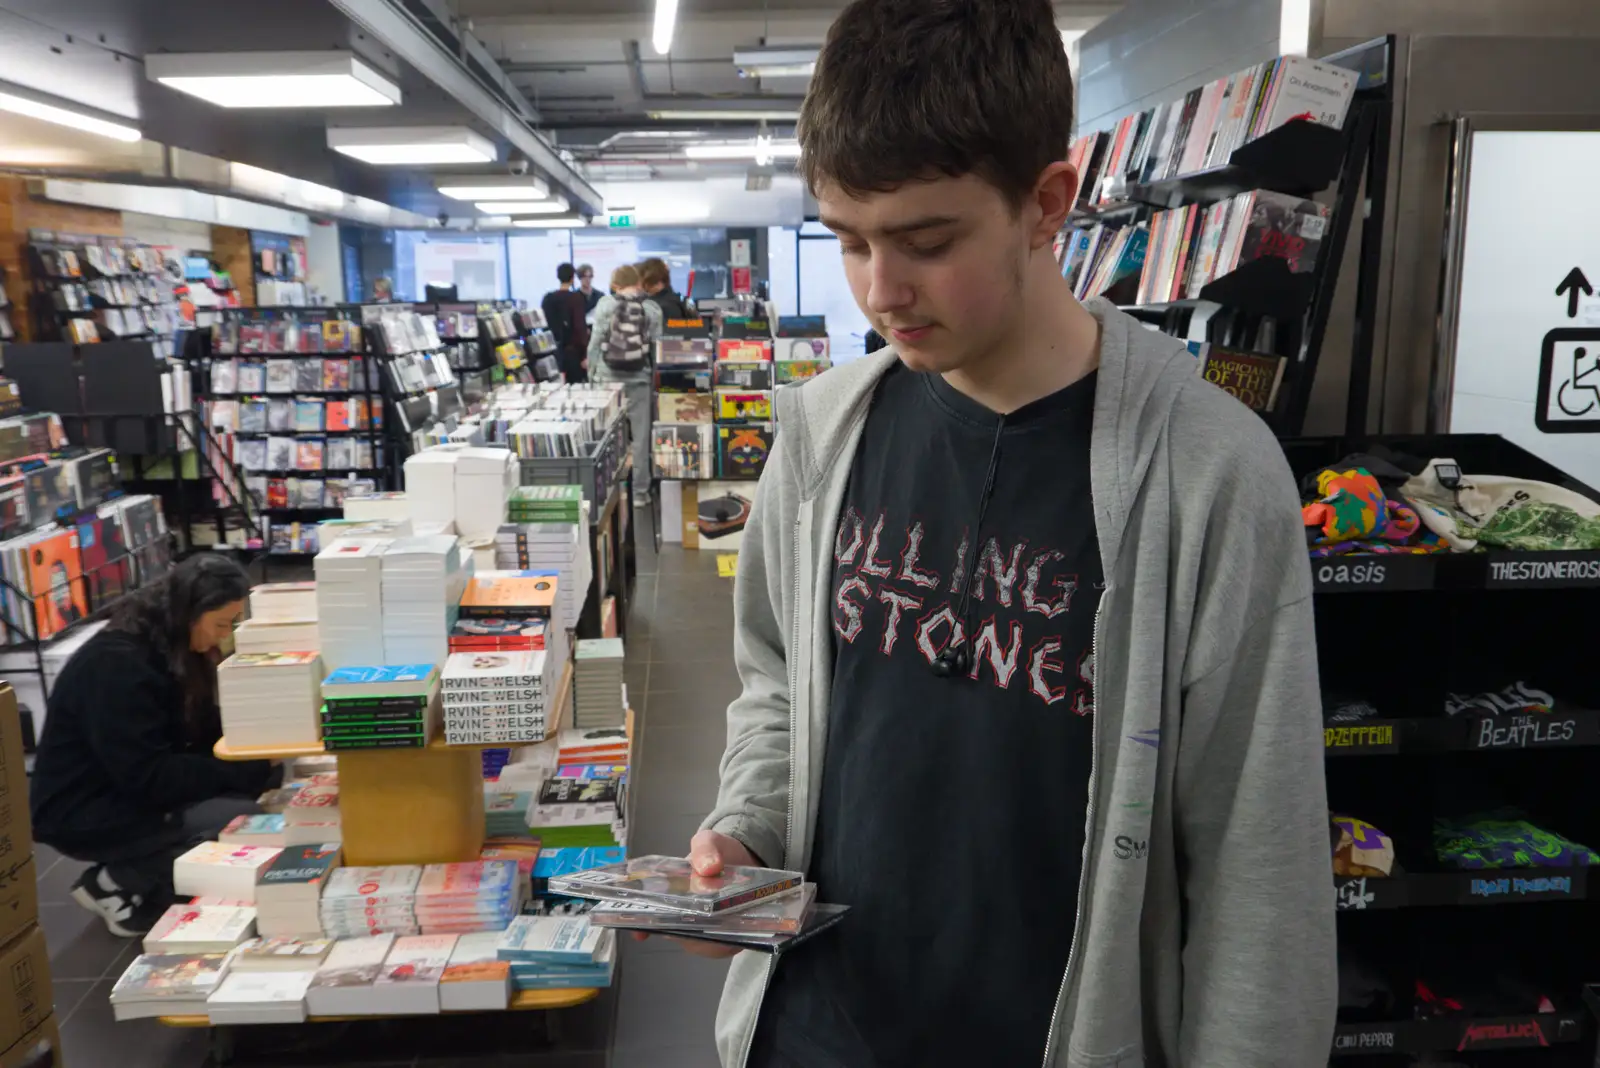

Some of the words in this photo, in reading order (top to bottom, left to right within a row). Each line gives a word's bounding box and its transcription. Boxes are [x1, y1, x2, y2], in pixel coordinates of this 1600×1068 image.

[1207, 359, 1274, 377] MAGICIANS
[1205, 368, 1231, 385] OF
[1235, 373, 1270, 392] THE
[1318, 560, 1386, 584] oasis
[1489, 560, 1600, 581] THESTONEROS
[493, 675, 542, 687] WELSH
[494, 690, 542, 701] WELSH
[495, 703, 544, 715] WELSH
[496, 716, 544, 728] WELSH
[1511, 715, 1533, 726] THE
[496, 730, 545, 741] WELSH
[1478, 719, 1576, 748] BEATLES
[264, 866, 324, 880] PAPILLON
[1458, 1017, 1549, 1051] METALLICA
